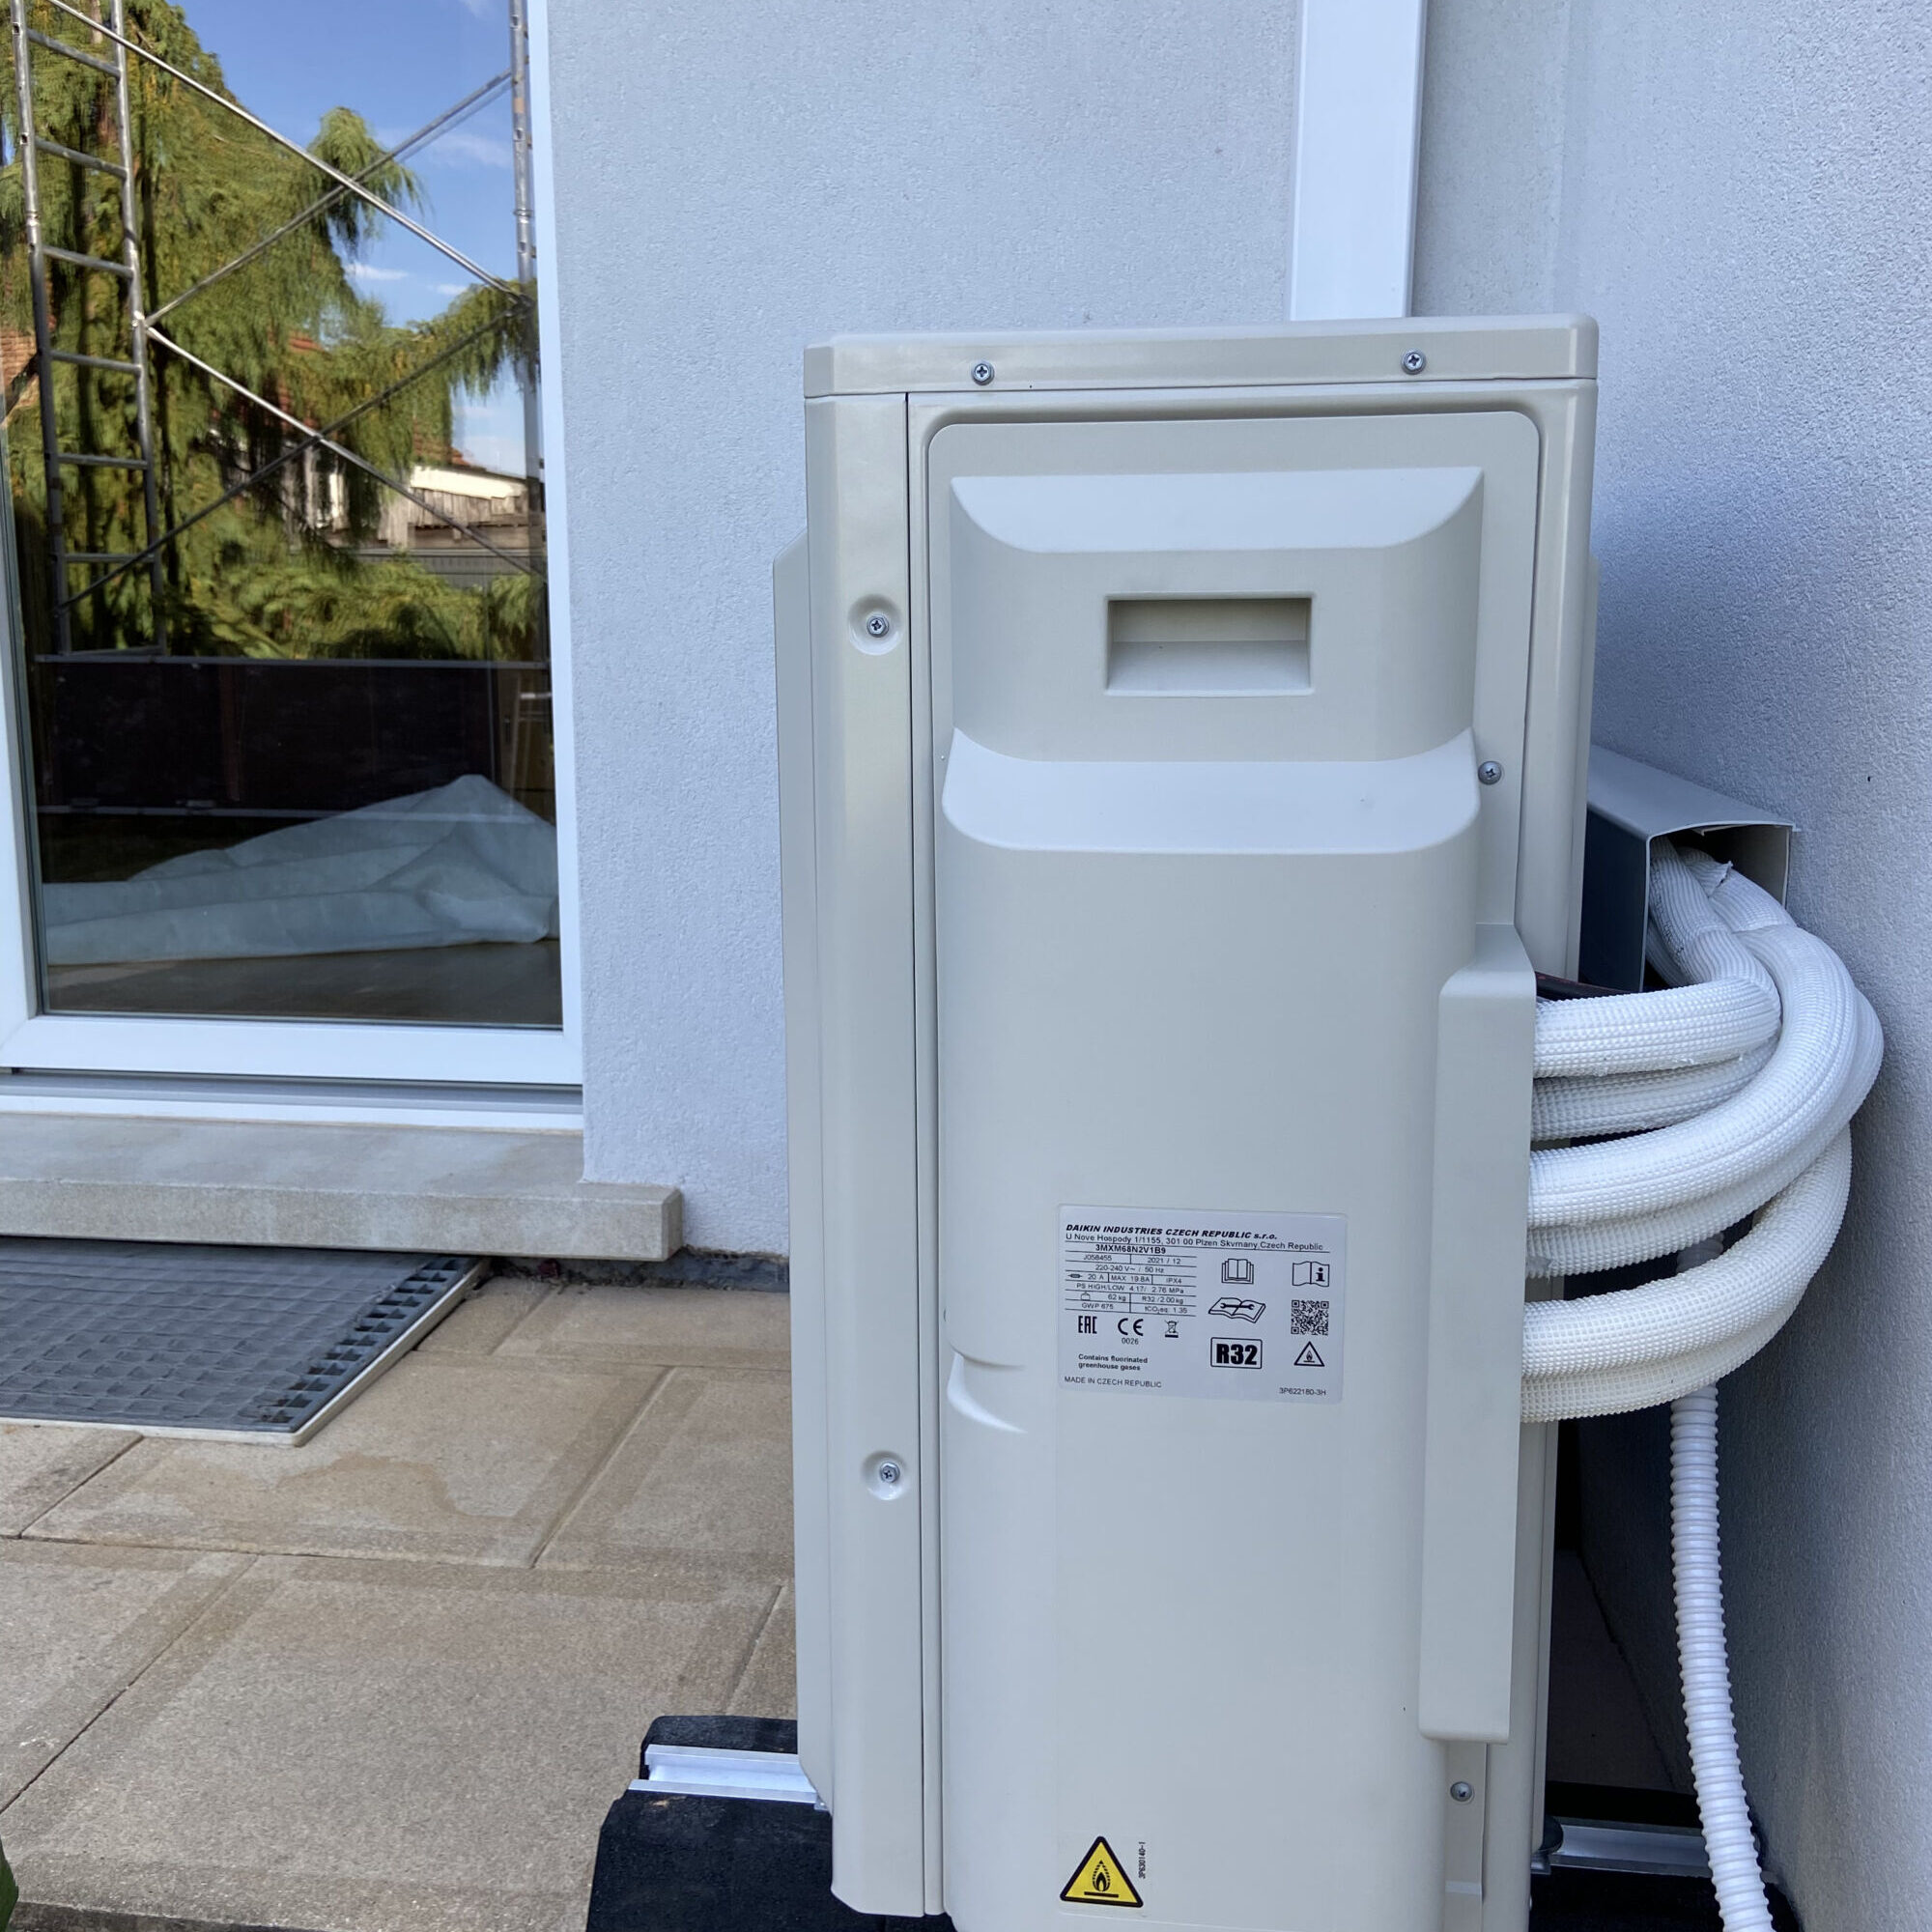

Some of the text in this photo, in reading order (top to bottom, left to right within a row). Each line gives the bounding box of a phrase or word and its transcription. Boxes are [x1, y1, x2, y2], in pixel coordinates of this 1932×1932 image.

[1066, 1224, 1100, 1232] DAIKIN
[1103, 1226, 1163, 1235] INDUSTRIES
[1202, 1230, 1251, 1238] REPUBLIC
[1097, 1235, 1131, 1243] Hospody
[1096, 1244, 1166, 1254] 3MXM68N2V1B9
[1216, 1343, 1258, 1365] R32
